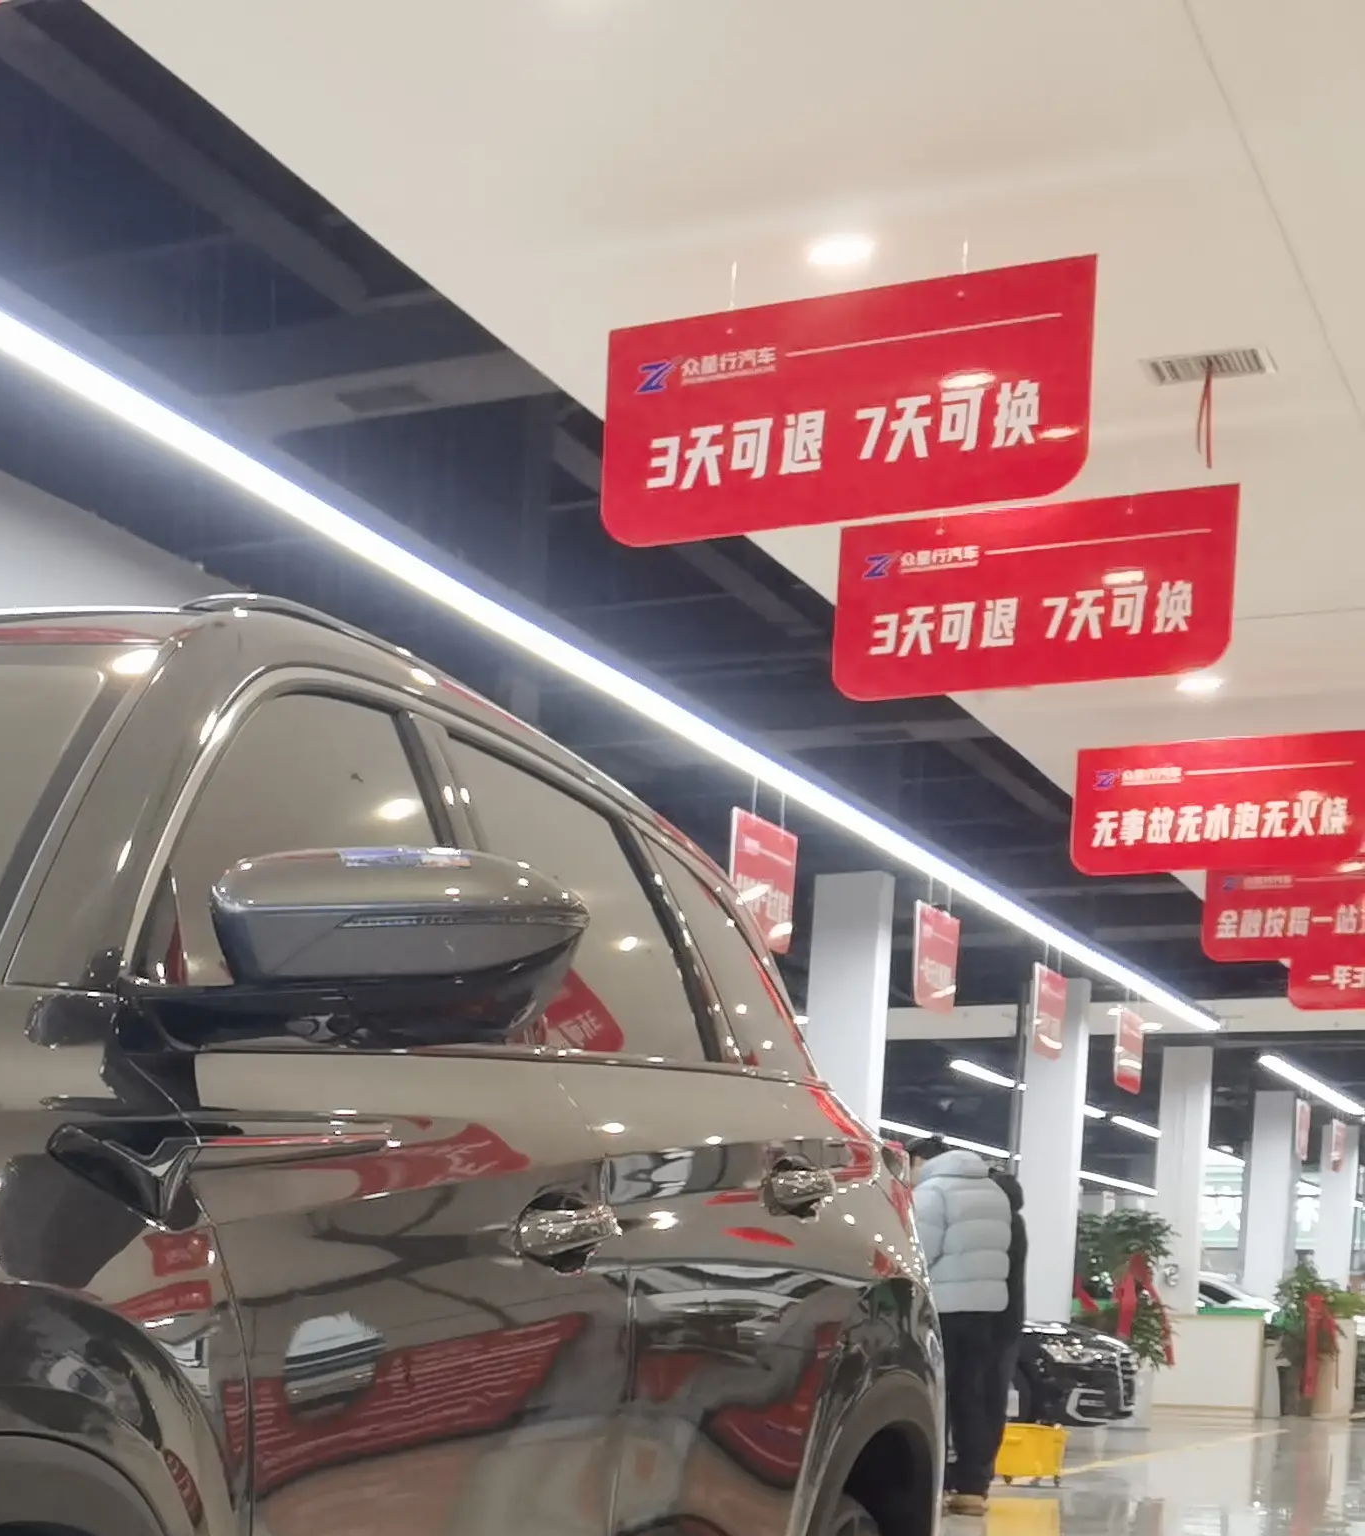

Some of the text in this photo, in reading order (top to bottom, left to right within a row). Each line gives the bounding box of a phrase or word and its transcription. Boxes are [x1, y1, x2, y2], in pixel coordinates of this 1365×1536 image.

[646, 379, 1041, 490] 3天可退 7天可换
[869, 579, 1194, 657] 3天可退 7天可换
[1091, 796, 1348, 848] 无事故无水泡无火烧
